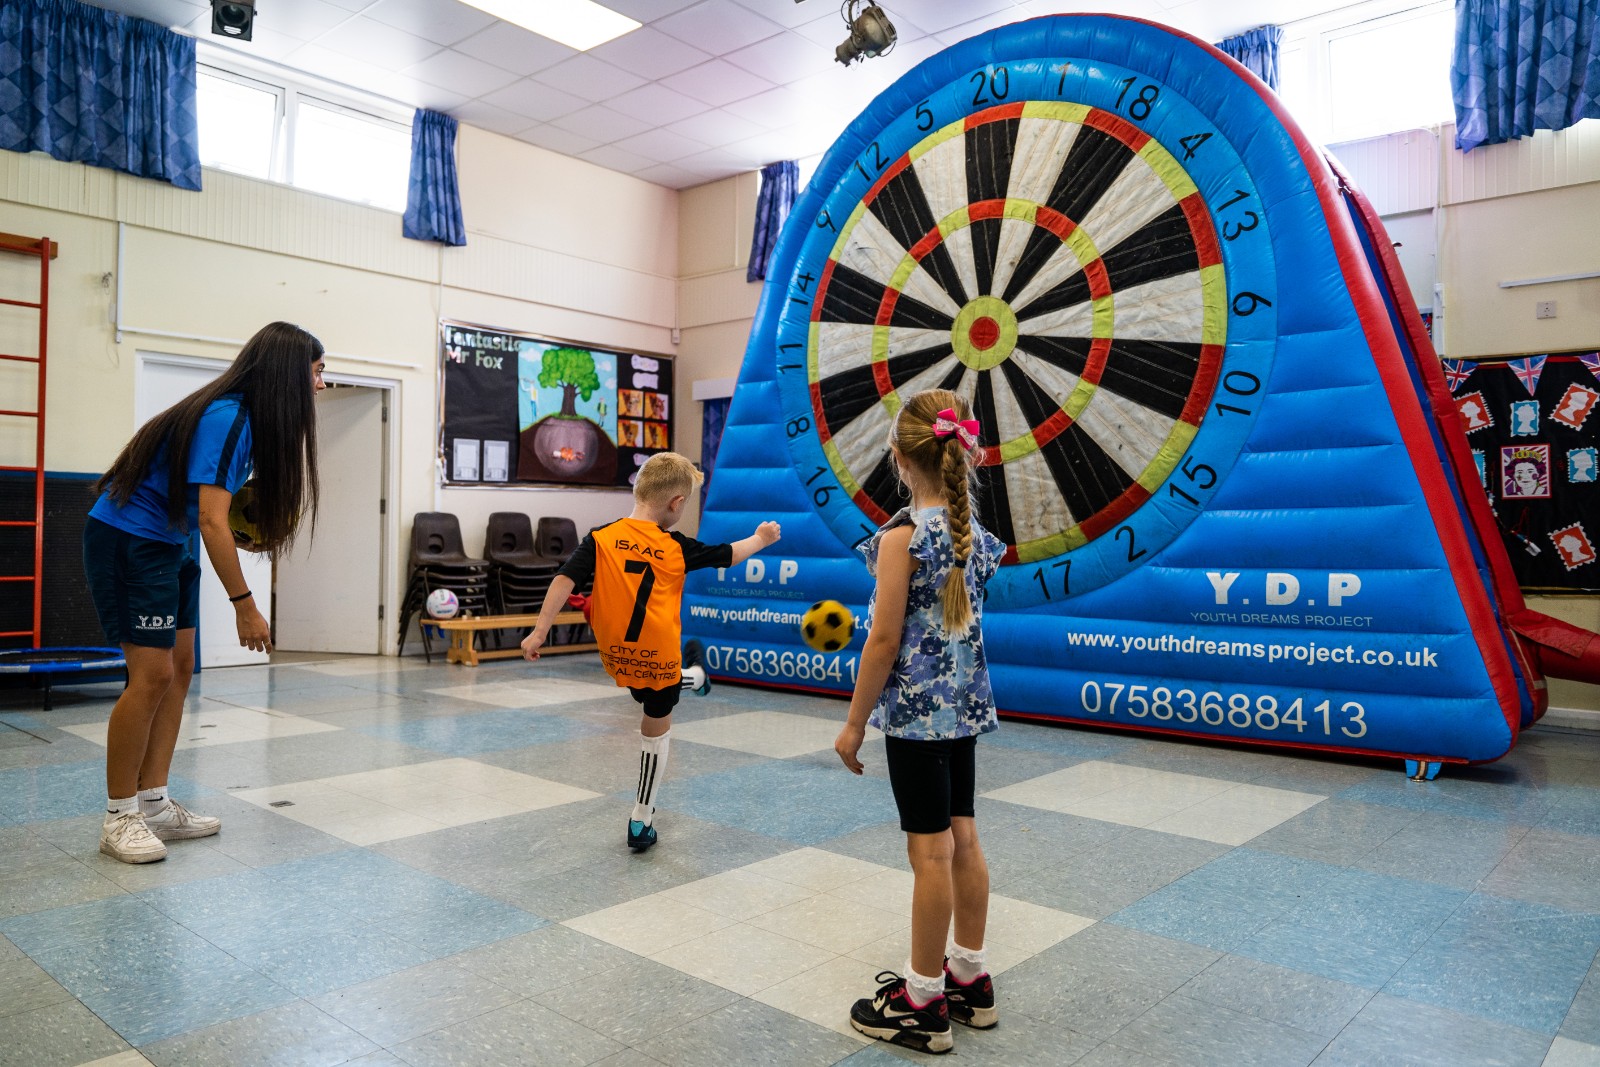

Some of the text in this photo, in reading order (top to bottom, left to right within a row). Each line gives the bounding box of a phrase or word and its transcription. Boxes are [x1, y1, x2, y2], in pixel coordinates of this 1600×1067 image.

[969, 66, 1009, 106] 20
[1057, 61, 1071, 96] 1
[915, 99, 934, 132] 5
[1115, 76, 1159, 121] 18
[853, 141, 890, 181] 12
[1179, 132, 1214, 161] 4
[815, 209, 837, 233] 9
[1215, 189, 1259, 242] 13
[790, 272, 815, 306] 14
[446, 327, 522, 352] Fantastic
[446, 345, 503, 370] Mr Fox
[778, 343, 803, 375] 11
[1215, 370, 1261, 416] 10
[786, 417, 810, 437] 8
[806, 466, 838, 507] 16
[1169, 455, 1218, 507] 15
[615, 539, 665, 561] ISAAC
[1114, 525, 1147, 562] 2
[707, 587, 805, 600] YOUTH DREAMS PROJECT
[1033, 559, 1072, 601] 17
[624, 559, 656, 643] 7
[1190, 612, 1374, 627] YOUTH DREAMS PROJECT
[609, 645, 658, 658] CITY OF
[706, 646, 856, 684] 0758368841
[634, 670, 677, 680] CENTRE
[1080, 680, 1368, 739] 07583688413
